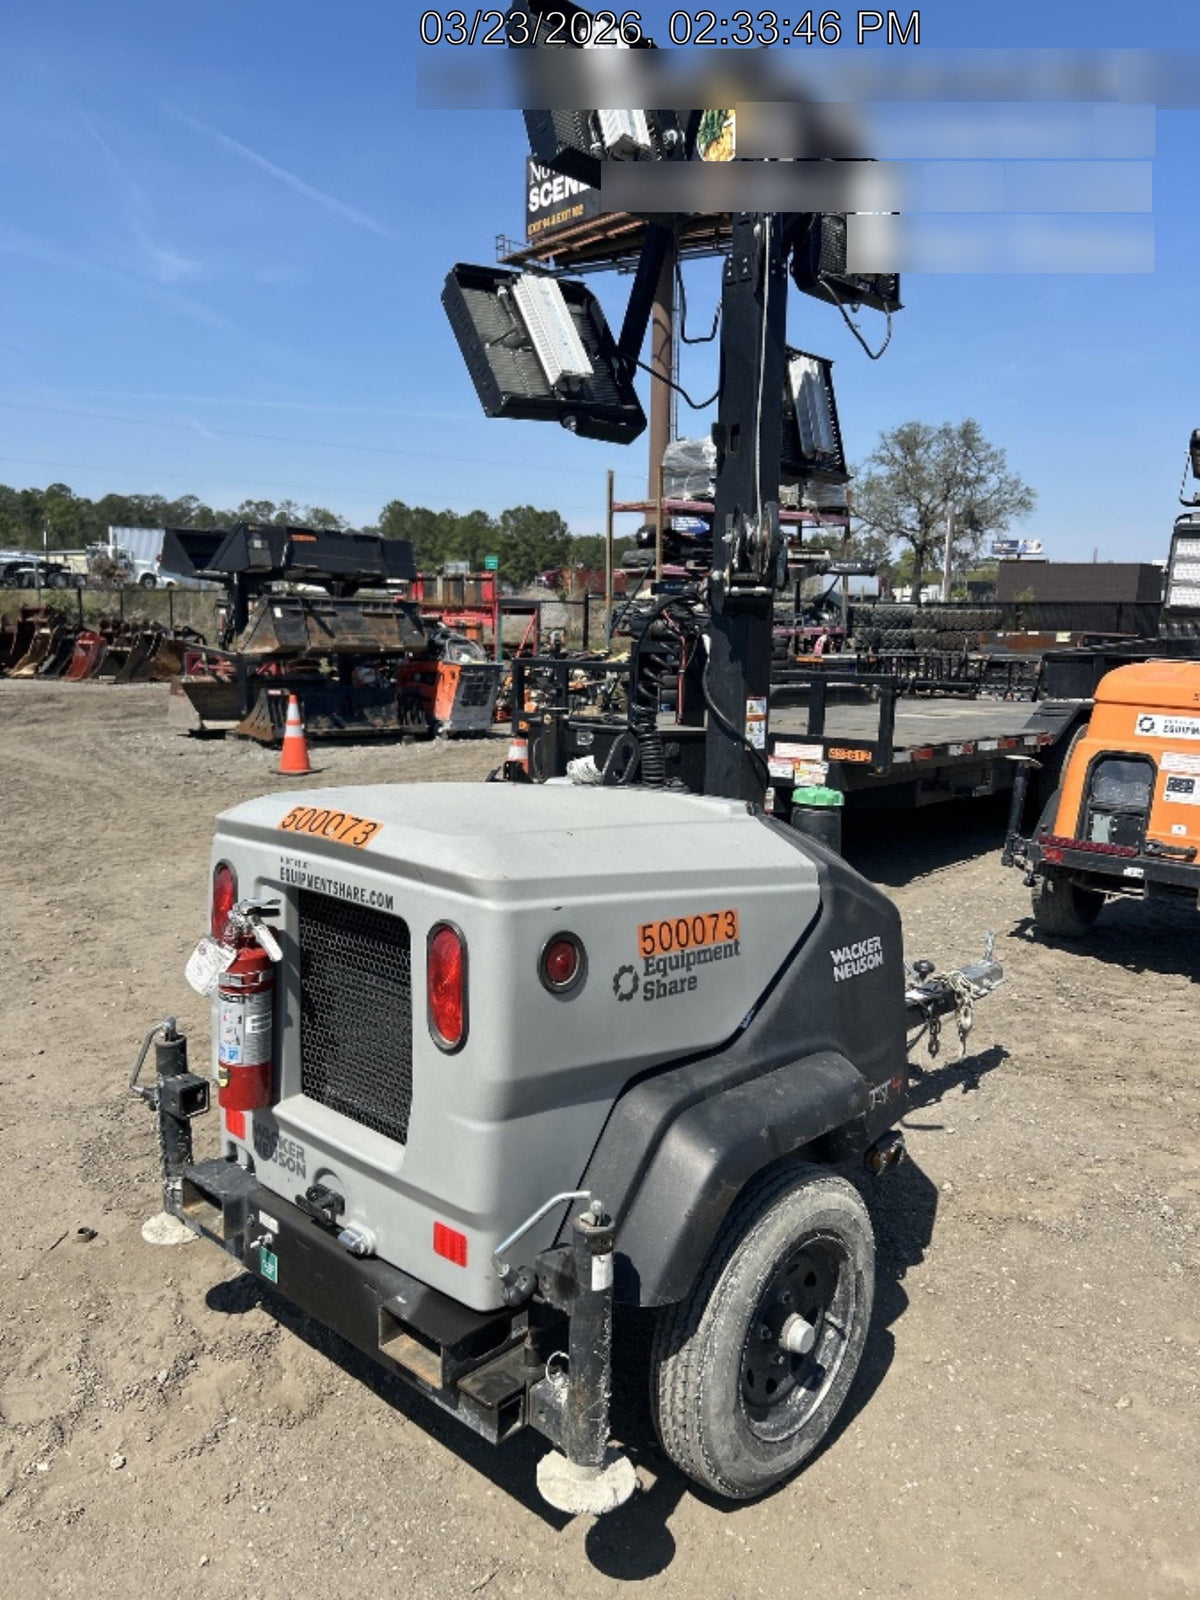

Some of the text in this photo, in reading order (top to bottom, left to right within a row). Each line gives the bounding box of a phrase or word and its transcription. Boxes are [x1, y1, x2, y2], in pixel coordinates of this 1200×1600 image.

[282, 807, 378, 846] 500073
[280, 866, 394, 911] EQUIPMENTSHARE.COM
[641, 910, 737, 955] 500073
[830, 936, 882, 965] WACKER
[643, 938, 741, 977] Equipment
[833, 951, 884, 982] NEUSON
[643, 975, 698, 1001] Share
